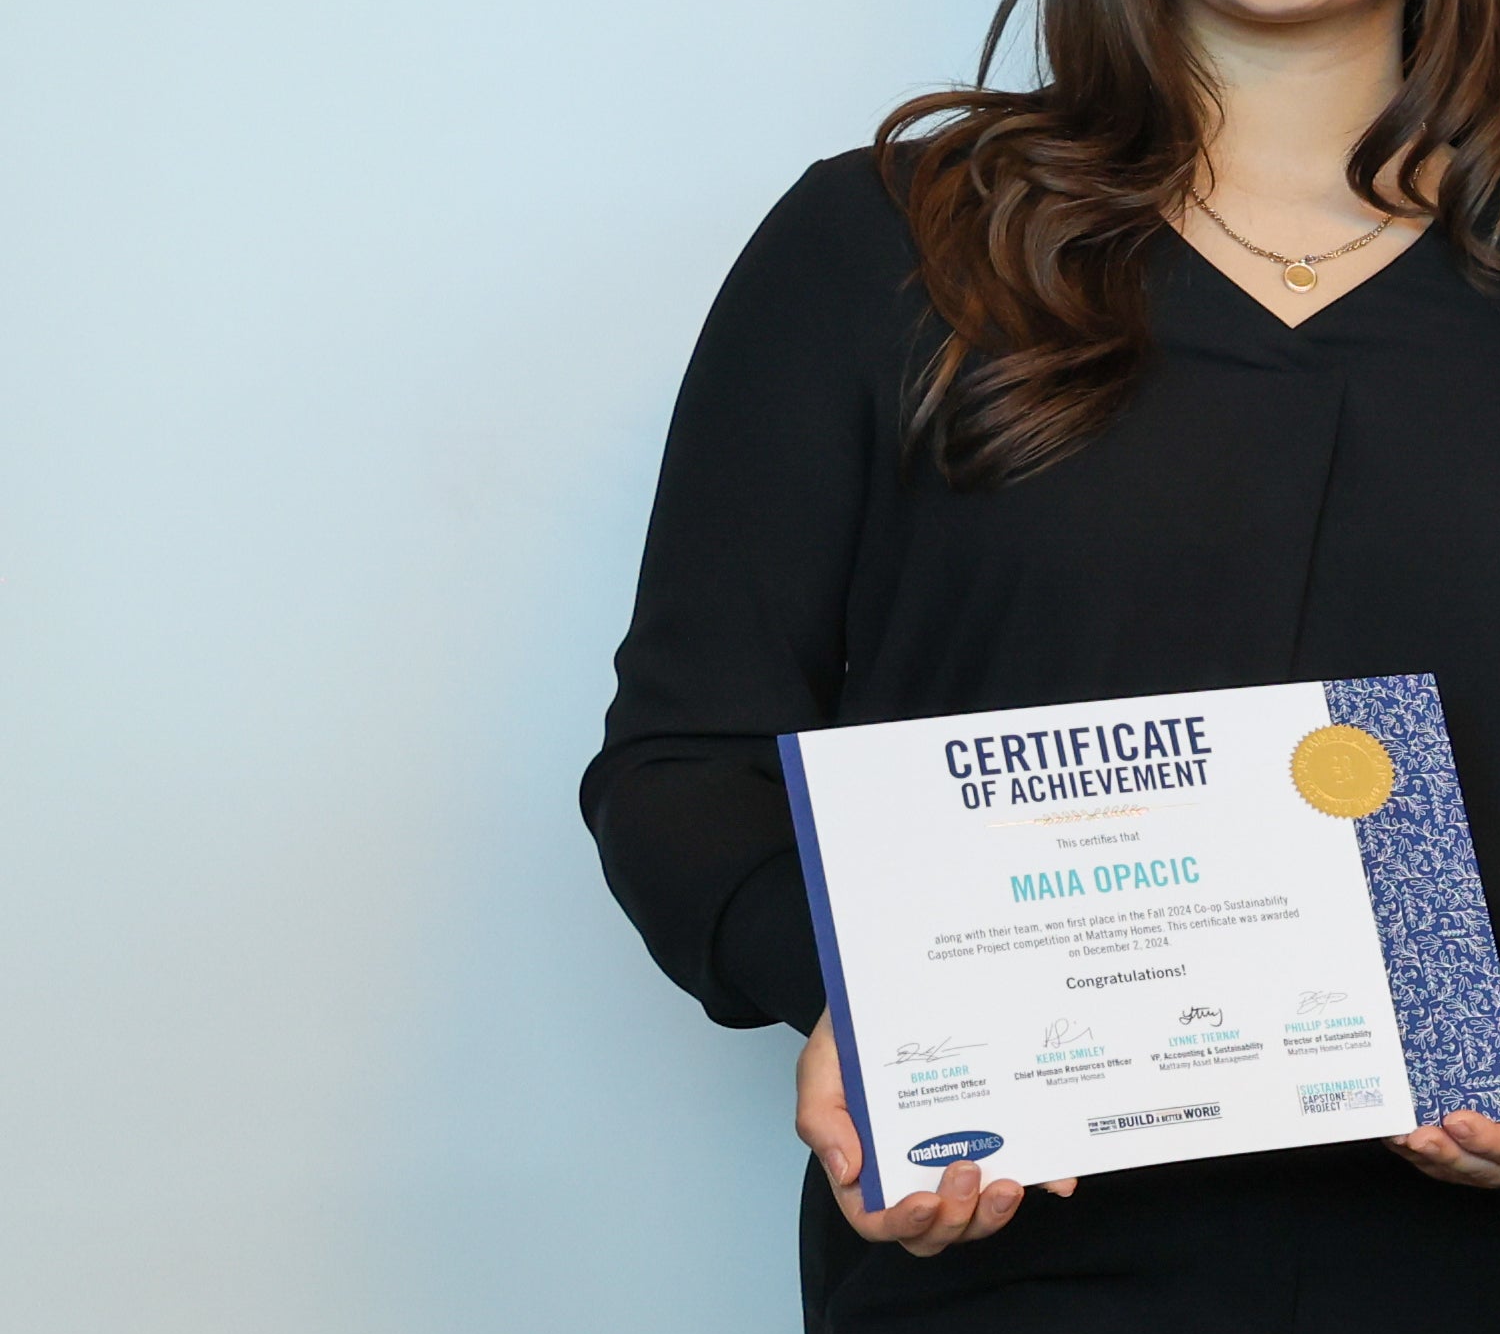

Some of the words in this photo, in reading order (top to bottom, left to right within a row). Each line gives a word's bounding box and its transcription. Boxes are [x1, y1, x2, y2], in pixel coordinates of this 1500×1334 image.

[945, 716, 1213, 779] CERTIFICATE
[961, 780, 997, 809] OF
[1010, 759, 1208, 805] ACHIEVEMENT
[1010, 869, 1086, 903] MAIA
[1093, 855, 1200, 894] OPACIC
[1066, 964, 1187, 990] Congratulations!
